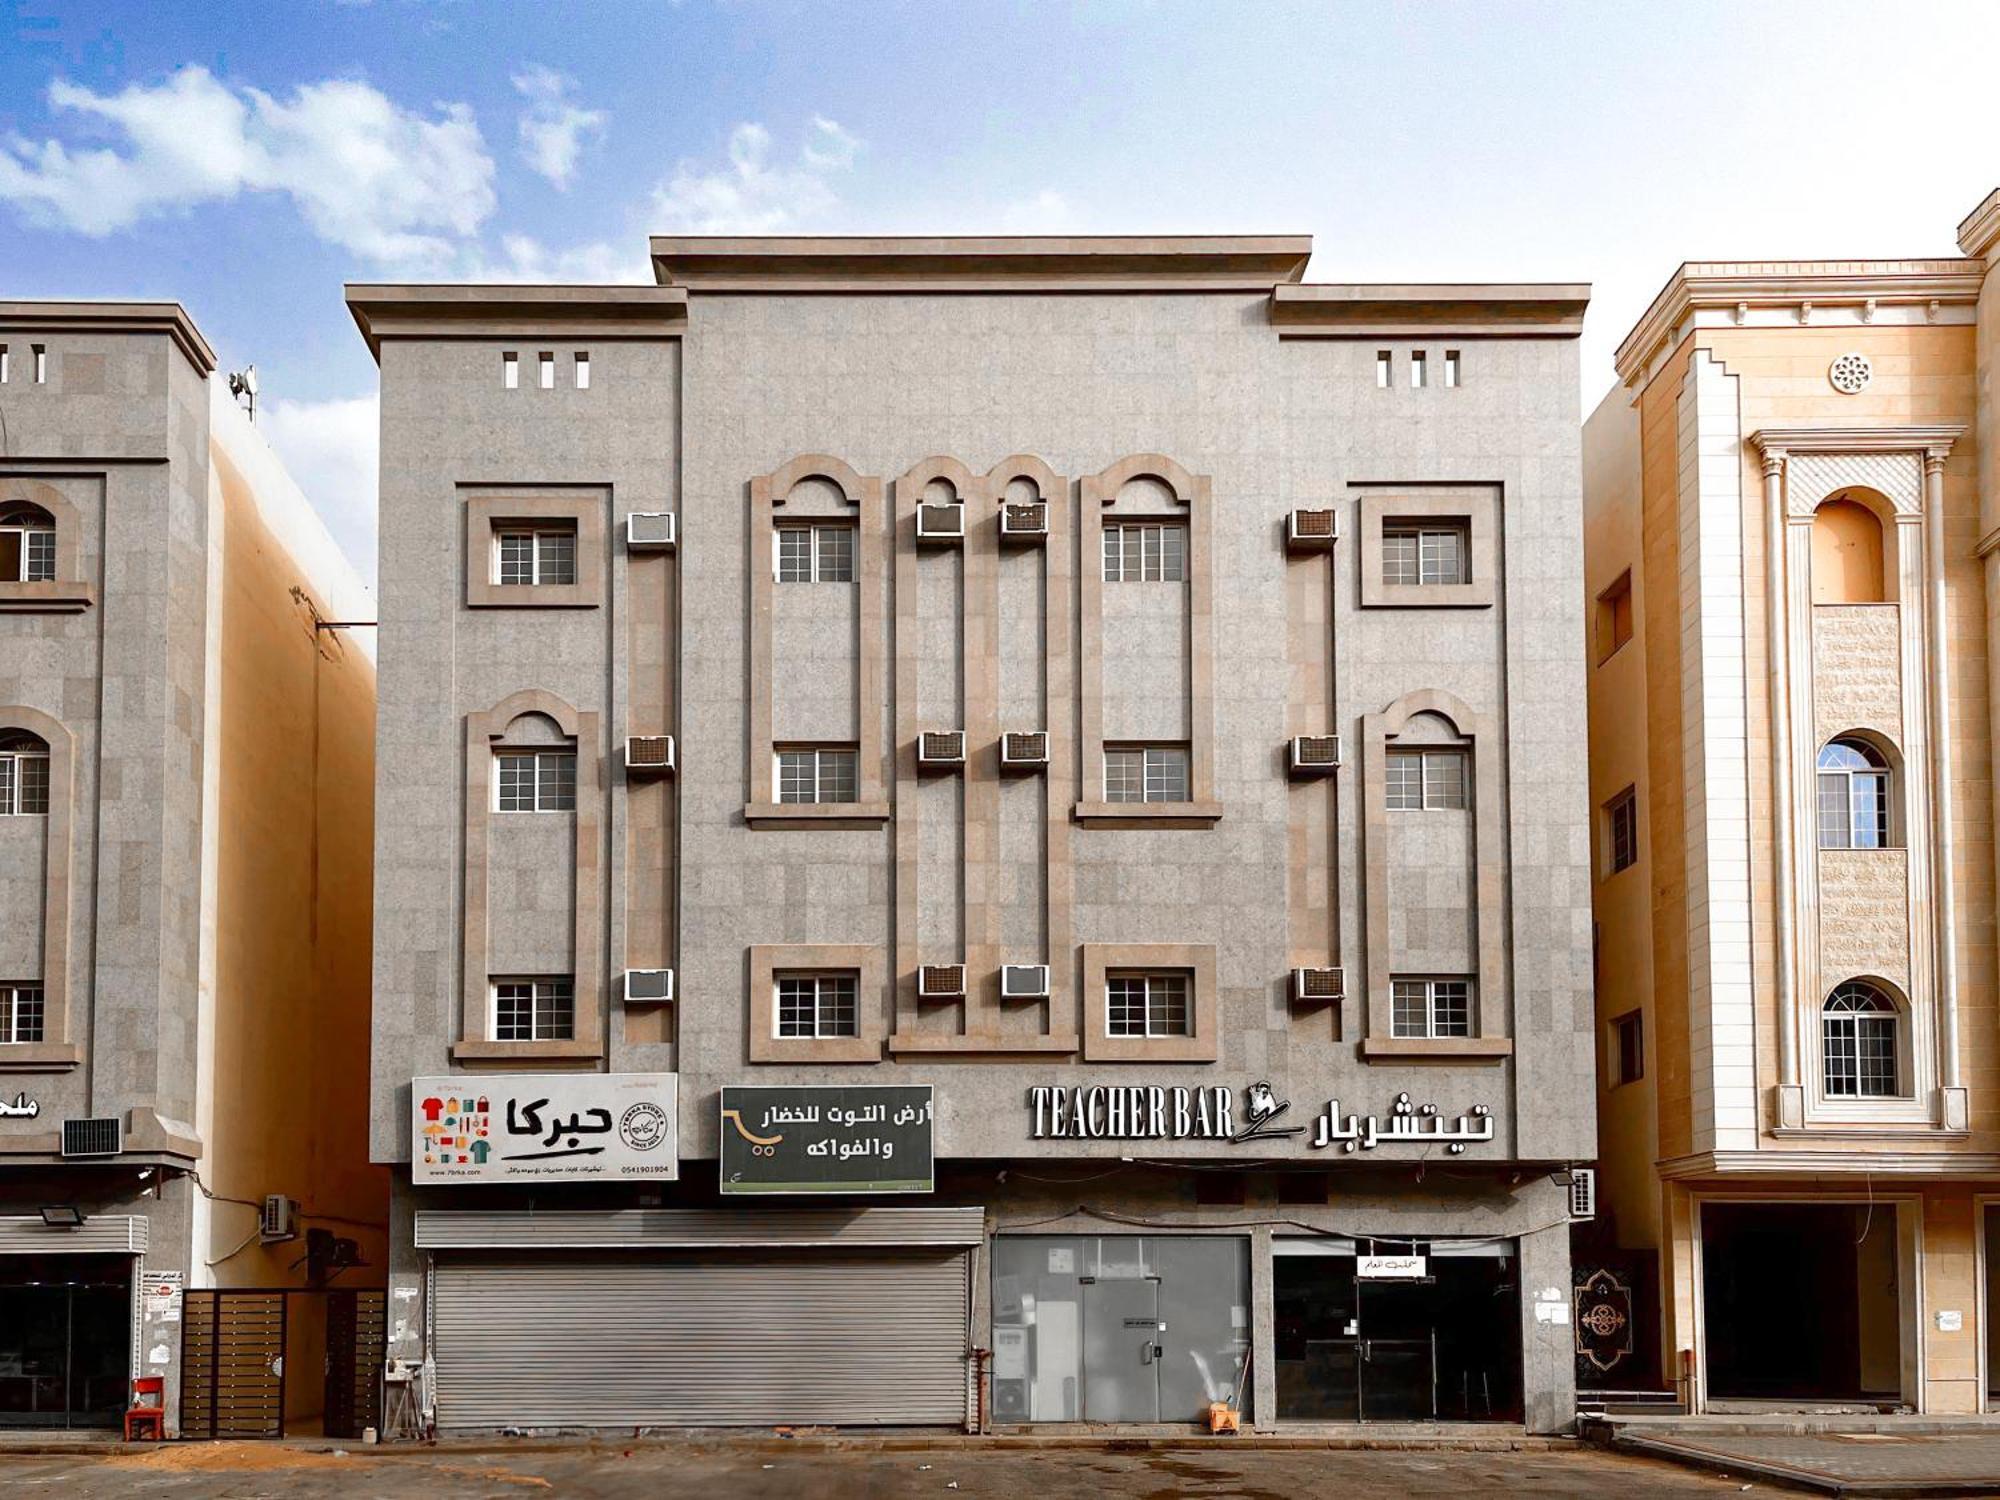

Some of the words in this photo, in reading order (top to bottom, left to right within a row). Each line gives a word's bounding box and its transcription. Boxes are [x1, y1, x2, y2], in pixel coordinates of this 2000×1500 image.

[761, 1106, 819, 1127] للخضار
[828, 1105, 885, 1127] التوت
[1031, 1087, 1166, 1137] TEACHER
[1173, 1087, 1233, 1137] BAR
[807, 1138, 893, 1160] والفواكه
